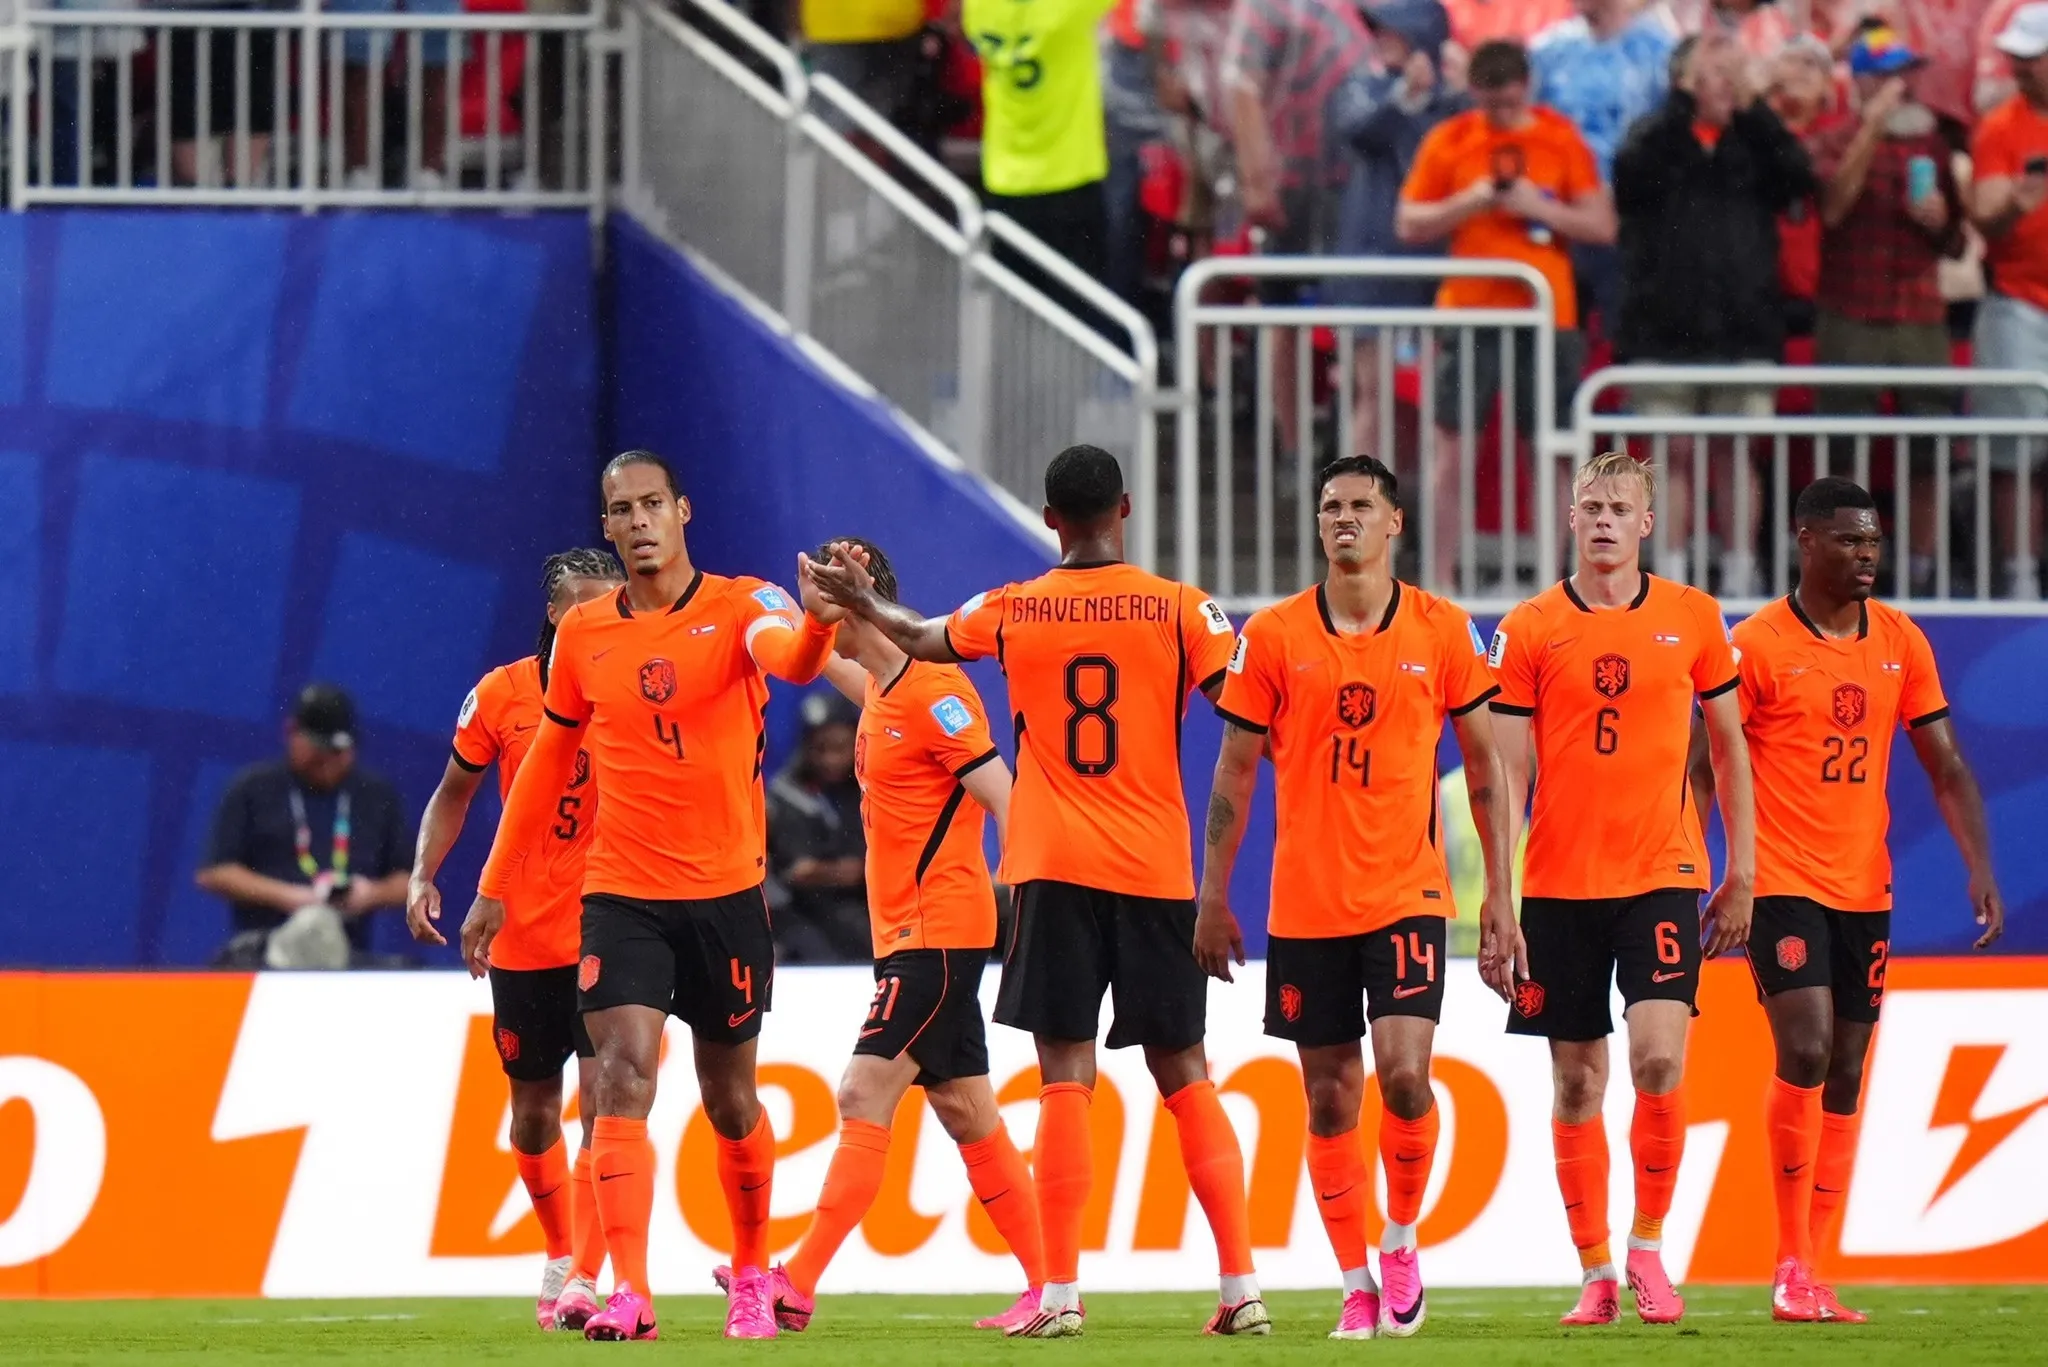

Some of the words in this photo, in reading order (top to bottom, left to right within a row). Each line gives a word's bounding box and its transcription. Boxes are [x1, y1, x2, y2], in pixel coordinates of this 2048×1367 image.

[1012, 594, 1169, 623] GRAVENBERCH
[654, 714, 685, 760] 4
[1065, 653, 1119, 777] 8
[1594, 707, 1621, 755] 6
[1330, 734, 1371, 787] 14
[1821, 735, 1869, 784] 22
[554, 796, 581, 840] 5
[1389, 932, 1435, 982] 14
[1653, 921, 1681, 965] 6
[1867, 939, 1890, 988] 2
[729, 957, 752, 1004] 4
